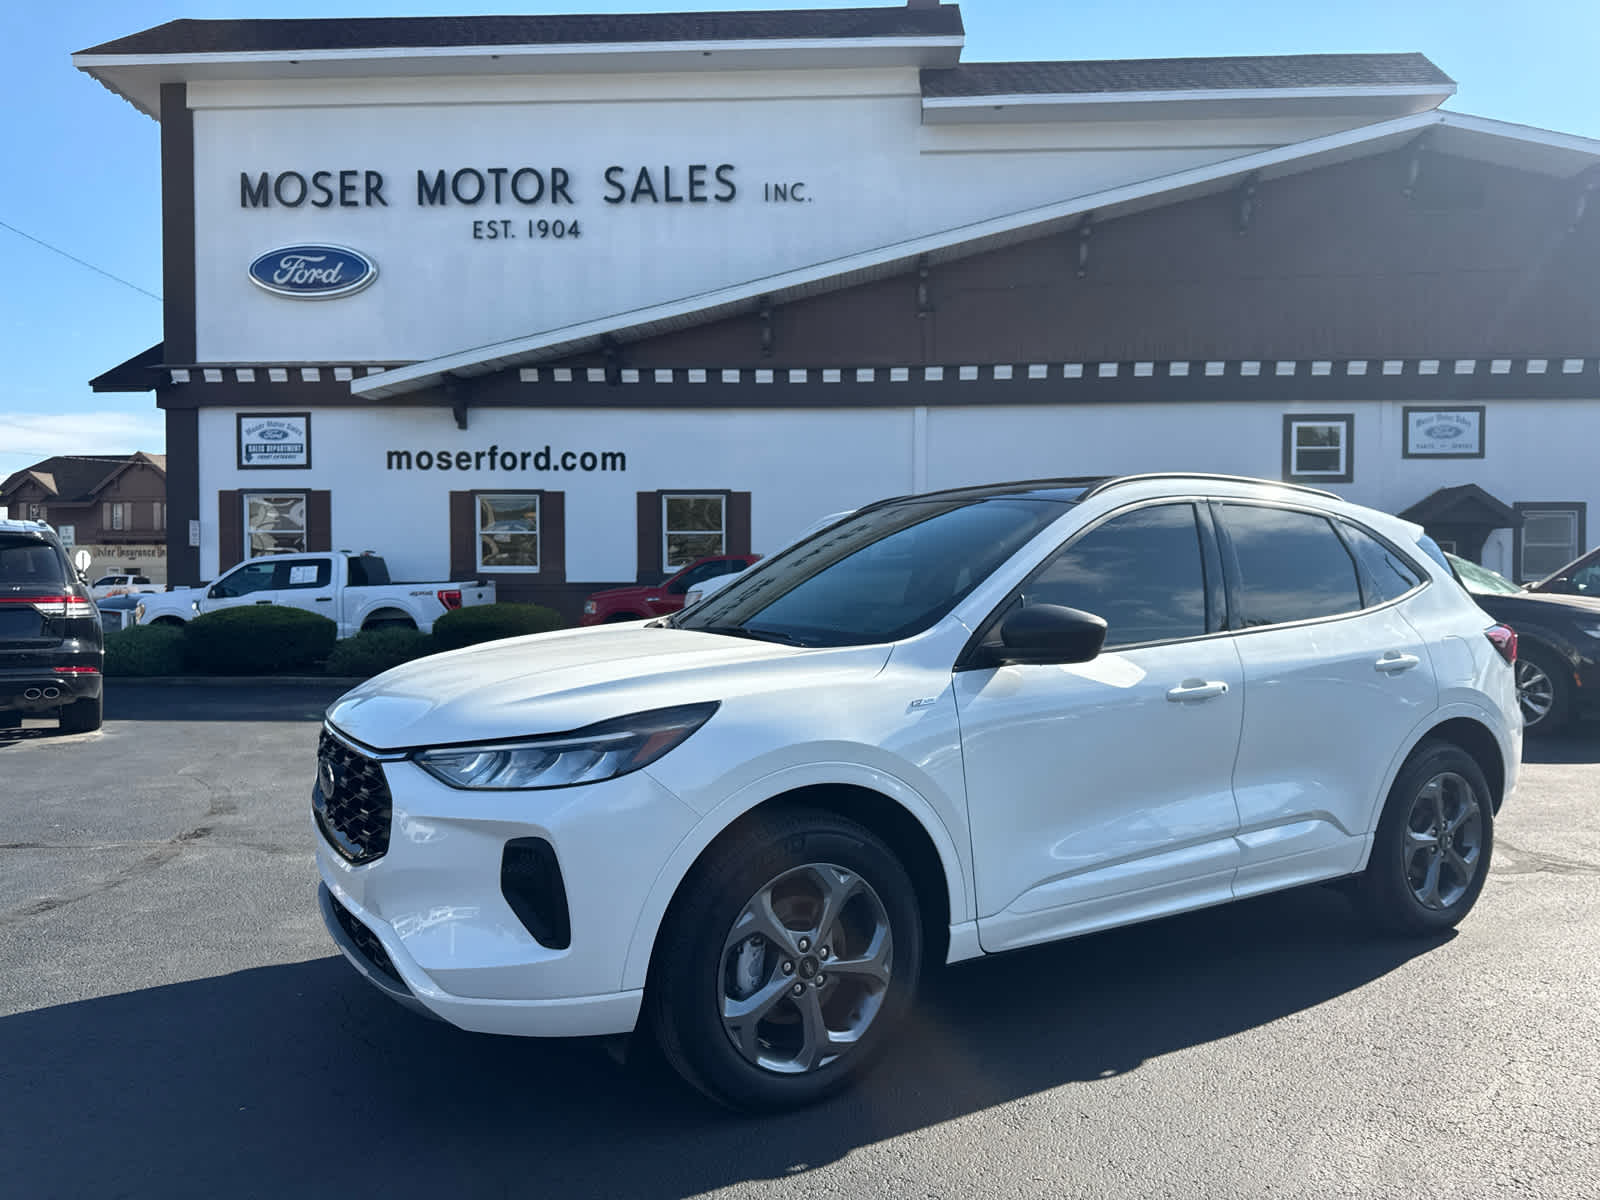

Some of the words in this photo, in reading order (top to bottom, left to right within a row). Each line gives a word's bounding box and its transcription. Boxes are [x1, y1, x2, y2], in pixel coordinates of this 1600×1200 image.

[241, 170, 388, 208] MOSER
[418, 168, 574, 206] MOTOR
[604, 164, 736, 205] SALES
[765, 182, 812, 203] INC.
[473, 220, 515, 240] EST.
[529, 220, 581, 239] 1904
[272, 254, 343, 285] Ford
[387, 445, 626, 471] moserford.com
